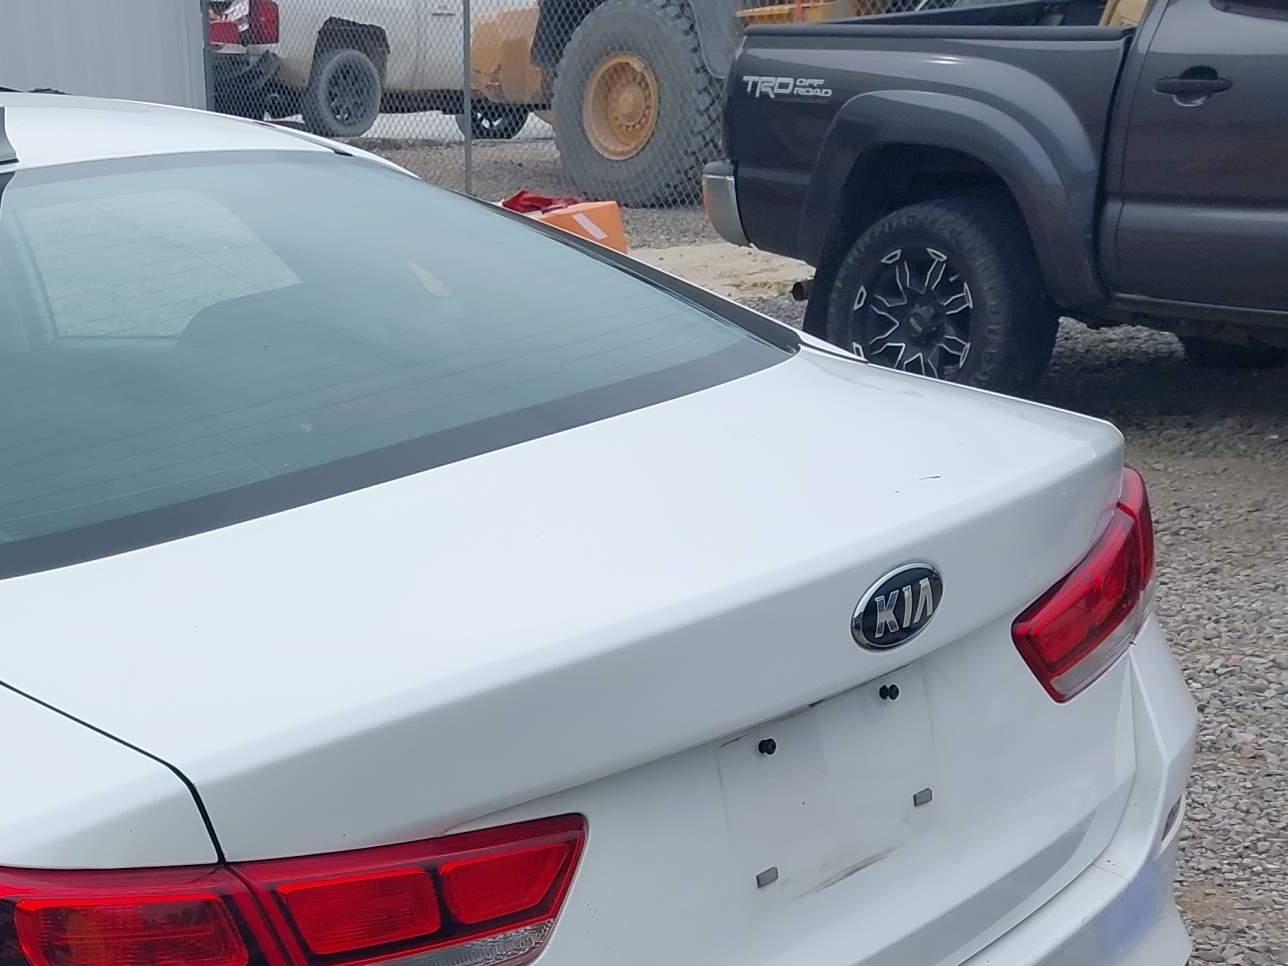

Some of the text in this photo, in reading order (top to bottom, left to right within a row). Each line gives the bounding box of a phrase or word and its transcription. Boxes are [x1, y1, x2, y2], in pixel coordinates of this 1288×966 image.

[743, 75, 794, 99] TRD
[795, 78, 825, 87] OFF
[793, 87, 832, 97] ROAD
[874, 577, 934, 639] KIA
